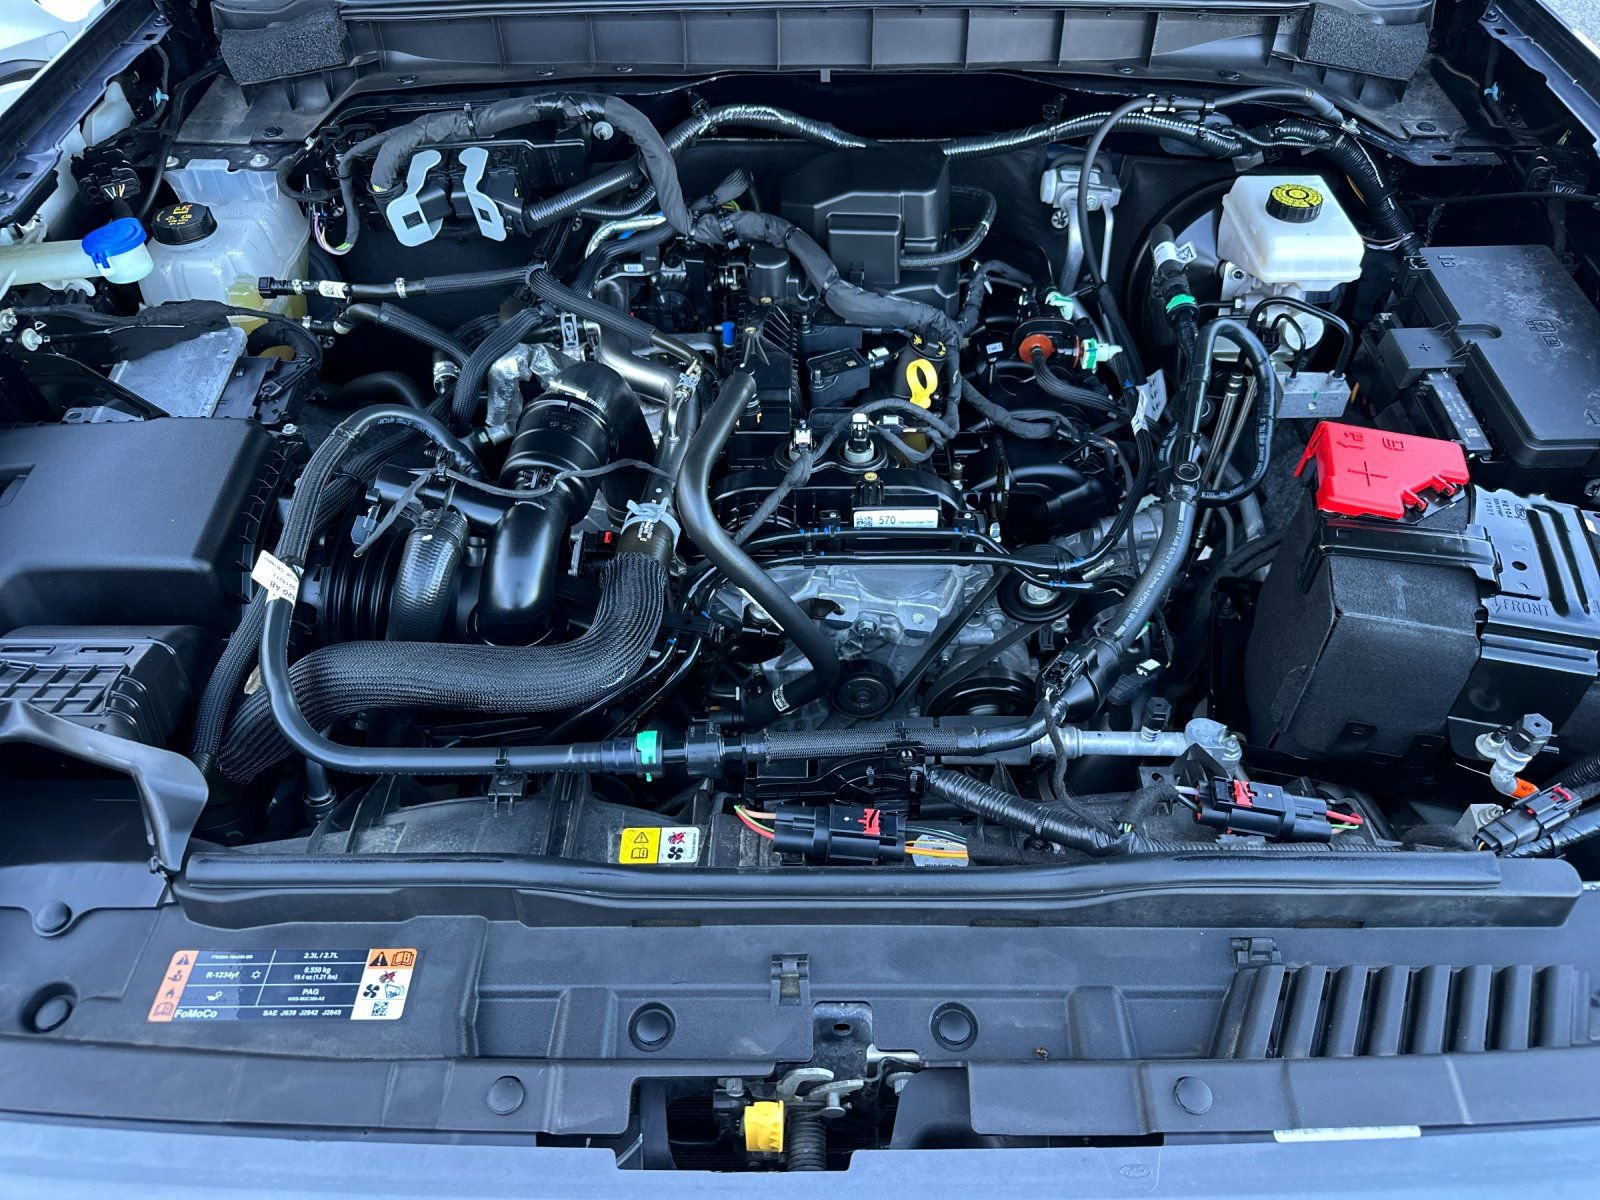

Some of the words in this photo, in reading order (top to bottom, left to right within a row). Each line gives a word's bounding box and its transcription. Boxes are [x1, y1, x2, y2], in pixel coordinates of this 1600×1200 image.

[878, 515, 896, 525] 570
[205, 971, 240, 980] R-1234yf
[173, 1009, 218, 1019] FoMoCo
